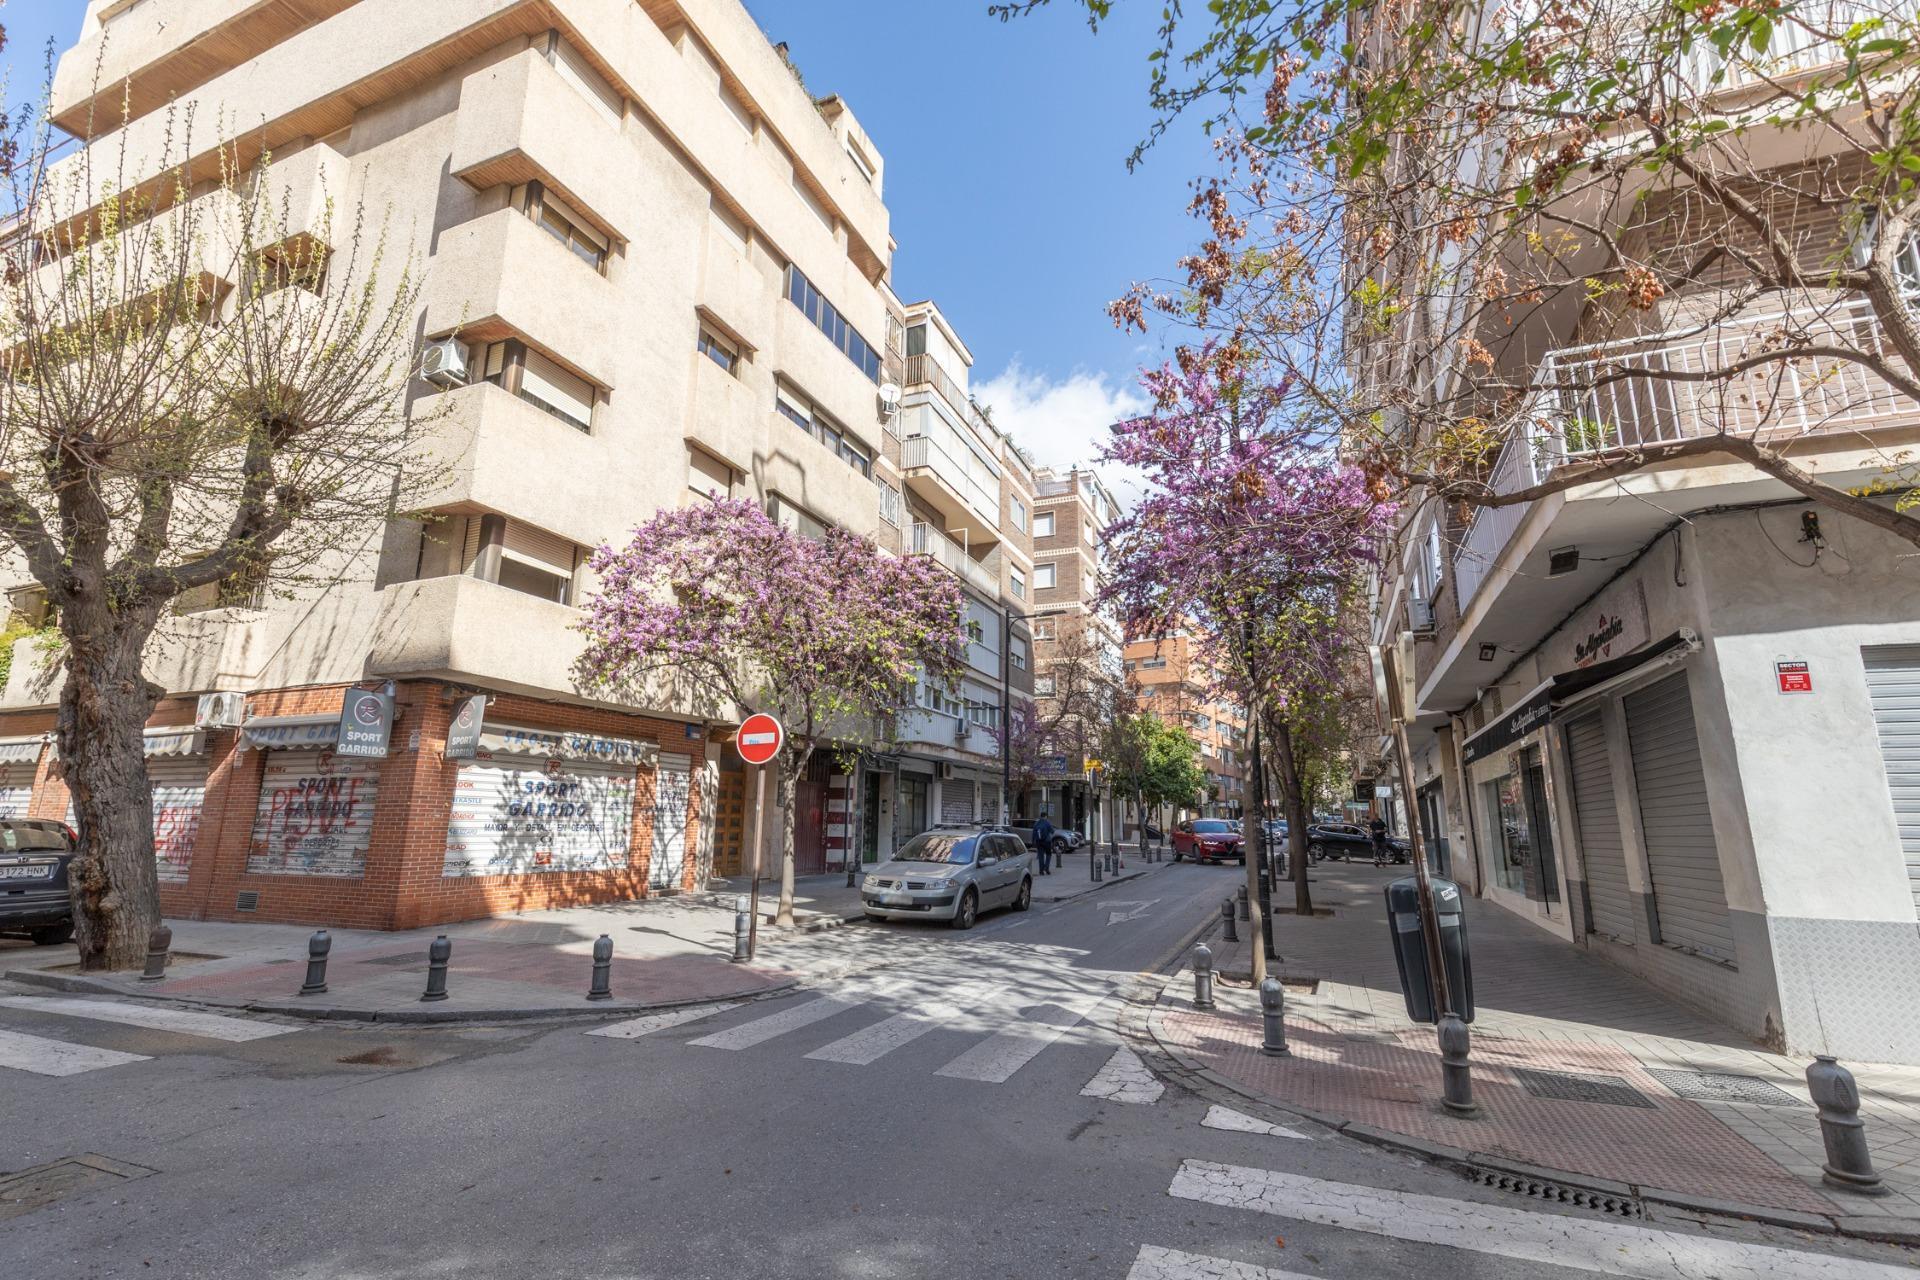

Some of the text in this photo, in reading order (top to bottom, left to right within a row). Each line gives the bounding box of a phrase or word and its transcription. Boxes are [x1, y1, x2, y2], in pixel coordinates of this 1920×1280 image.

[346, 731, 383, 743] SPORT
[451, 735, 474, 746] SPORT
[337, 743, 387, 756] GARRIDO
[525, 780, 578, 797] SPORT
[508, 801, 588, 817] GARRIDO
[484, 823, 508, 832] MAYOR
[27, 865, 46, 875] HNK
